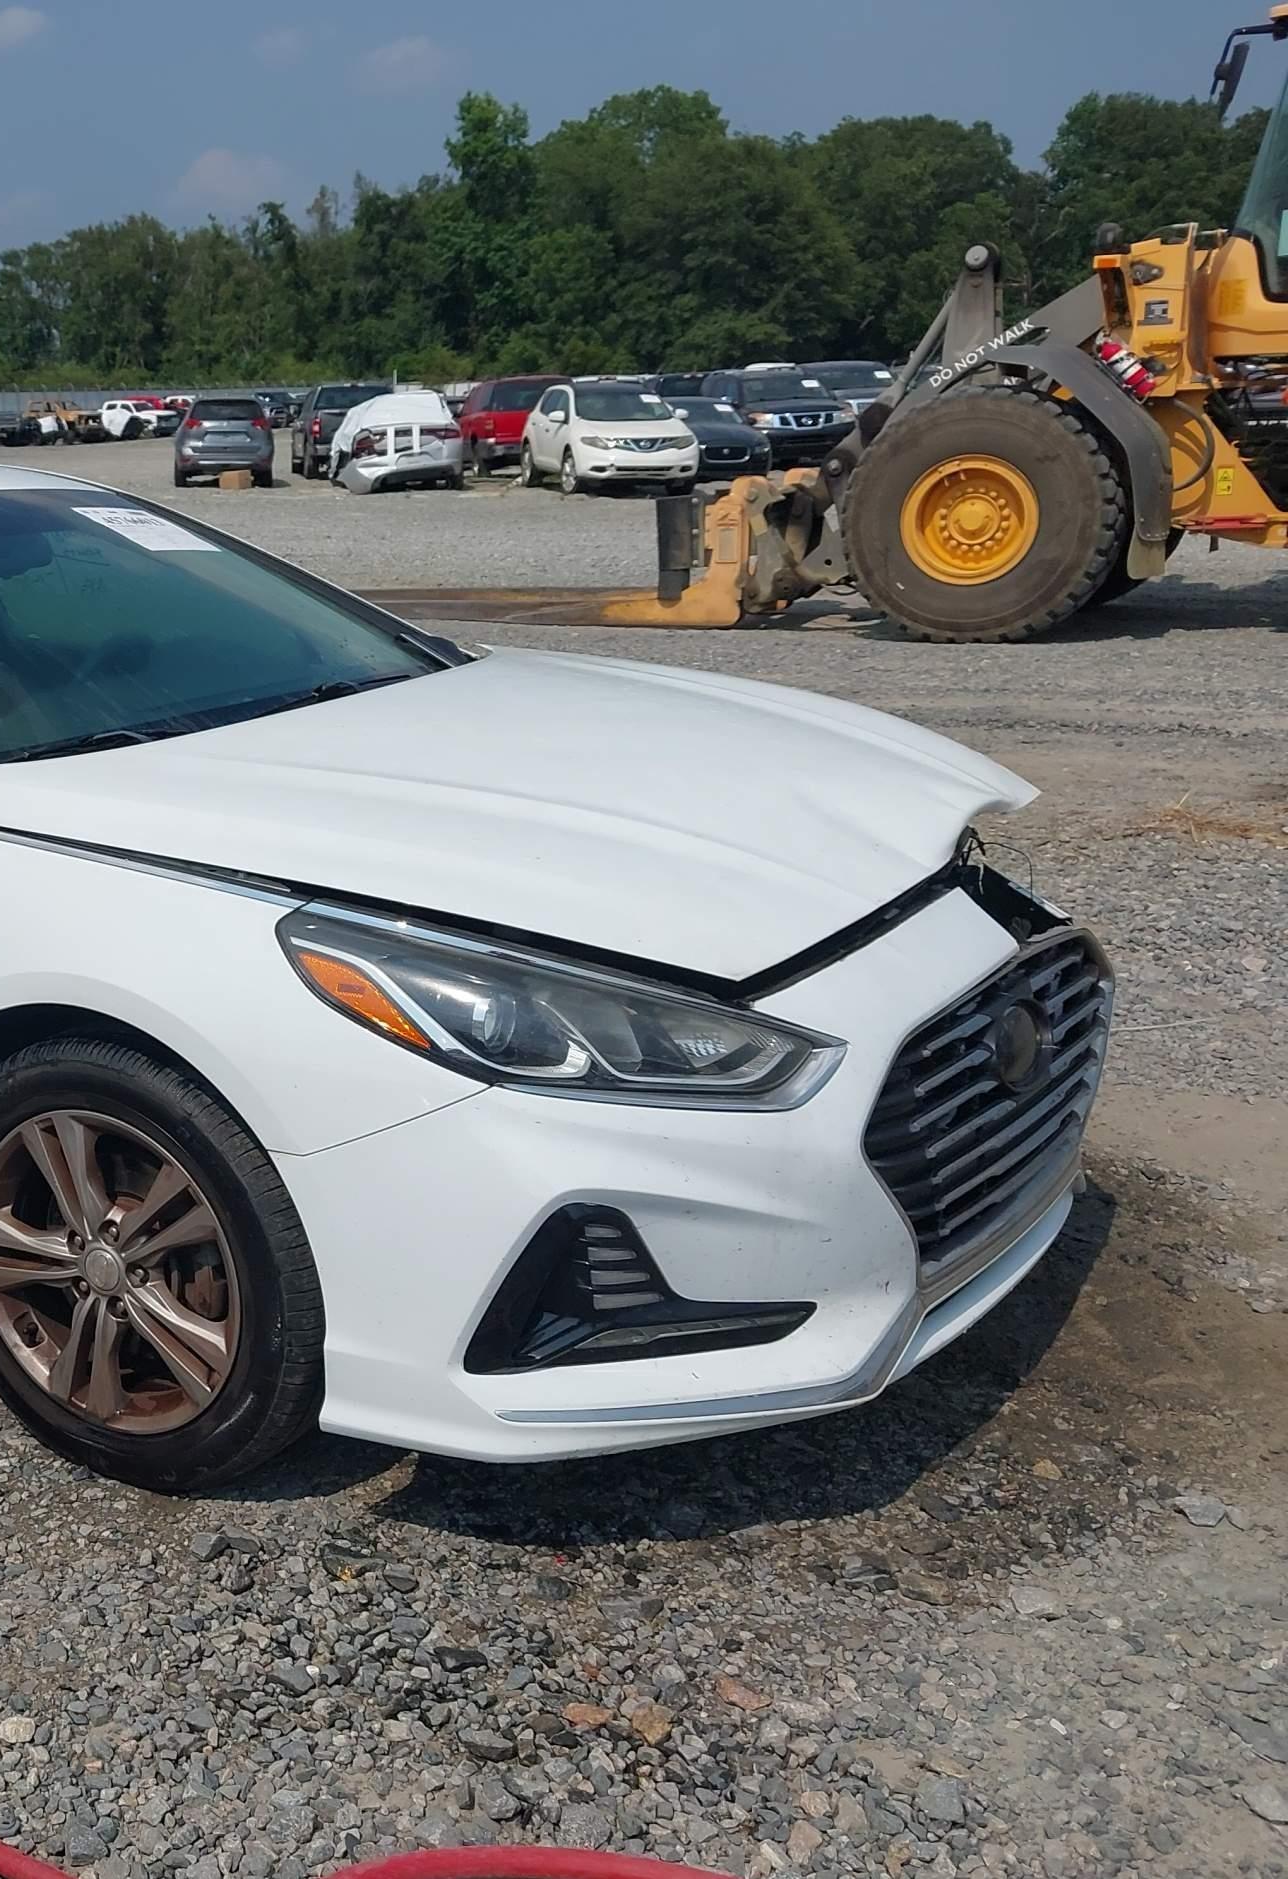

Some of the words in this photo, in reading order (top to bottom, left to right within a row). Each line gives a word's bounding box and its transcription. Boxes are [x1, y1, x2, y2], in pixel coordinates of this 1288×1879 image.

[929, 368, 953, 388] DO
[953, 346, 985, 372] NOT
[987, 318, 1035, 349] WALK
